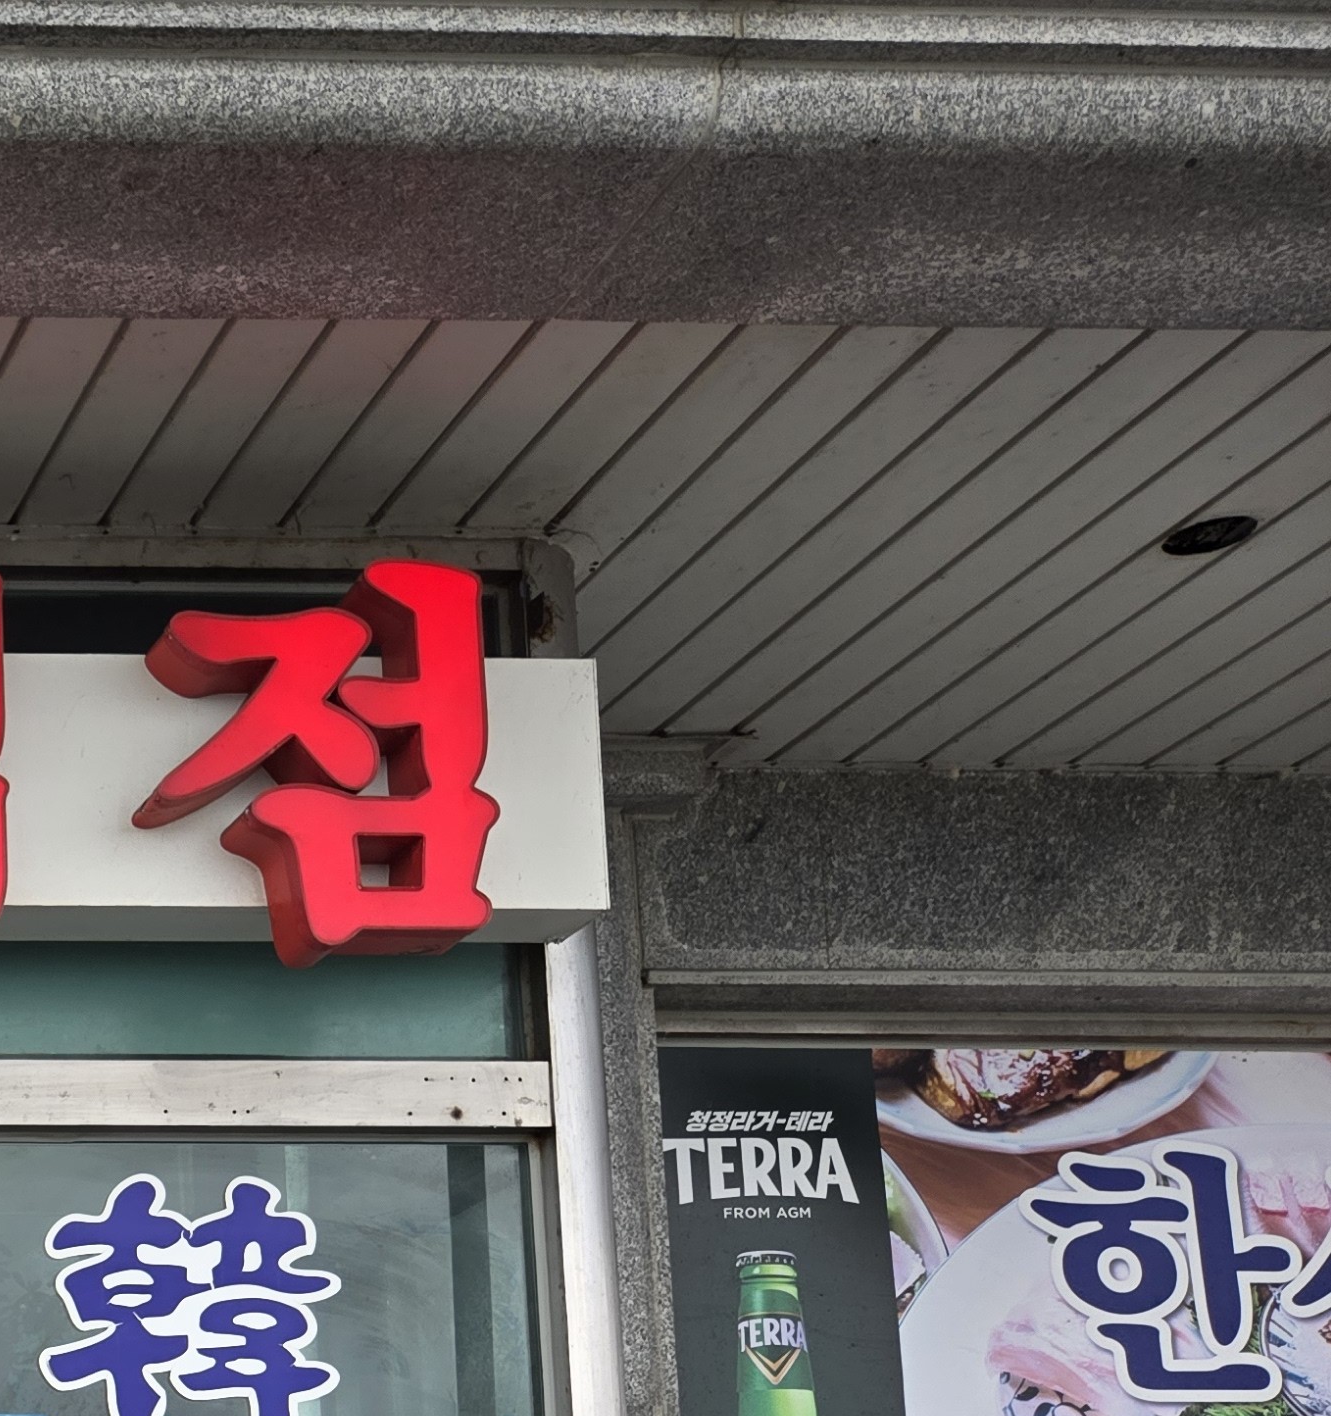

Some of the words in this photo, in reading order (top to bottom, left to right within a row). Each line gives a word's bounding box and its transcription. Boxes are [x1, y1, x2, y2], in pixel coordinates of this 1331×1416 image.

[685, 1110, 835, 1132] 청정라거-테라
[662, 1137, 861, 1205] TERRA
[723, 1207, 771, 1219] FROM
[776, 1206, 812, 1219] AGM
[1018, 1139, 1331, 1402] 한
[737, 1317, 808, 1353] TERRA
